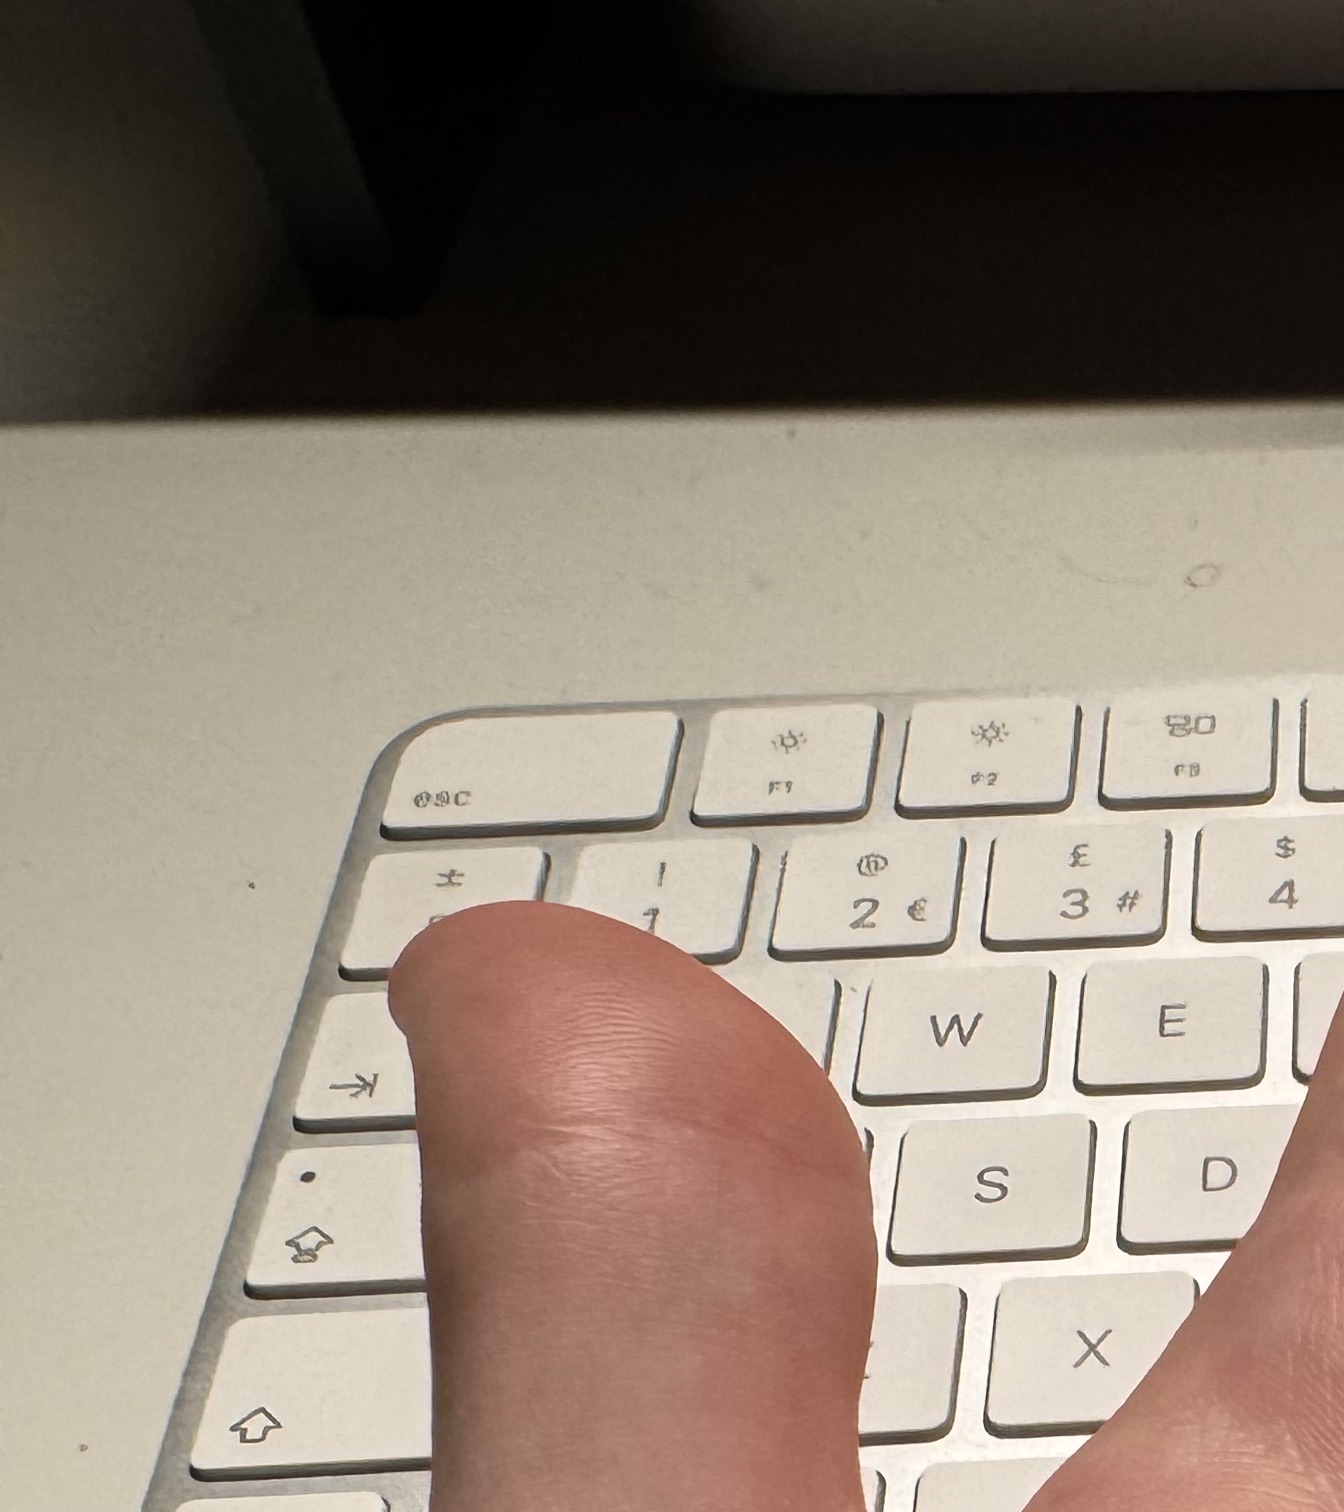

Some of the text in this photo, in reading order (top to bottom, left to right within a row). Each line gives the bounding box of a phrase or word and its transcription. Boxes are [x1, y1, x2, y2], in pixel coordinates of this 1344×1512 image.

[414, 791, 471, 808] esc
[1069, 844, 1090, 867] £
[1275, 836, 1295, 859] $
[1060, 888, 1139, 919] 3 #
[1268, 879, 1298, 909] 4
[849, 898, 879, 929] 2
[930, 1013, 983, 1047] W
[1159, 1004, 1186, 1037] E
[974, 1167, 1008, 1203] S
[1202, 1157, 1237, 1192] D
[1073, 1329, 1112, 1368] X
